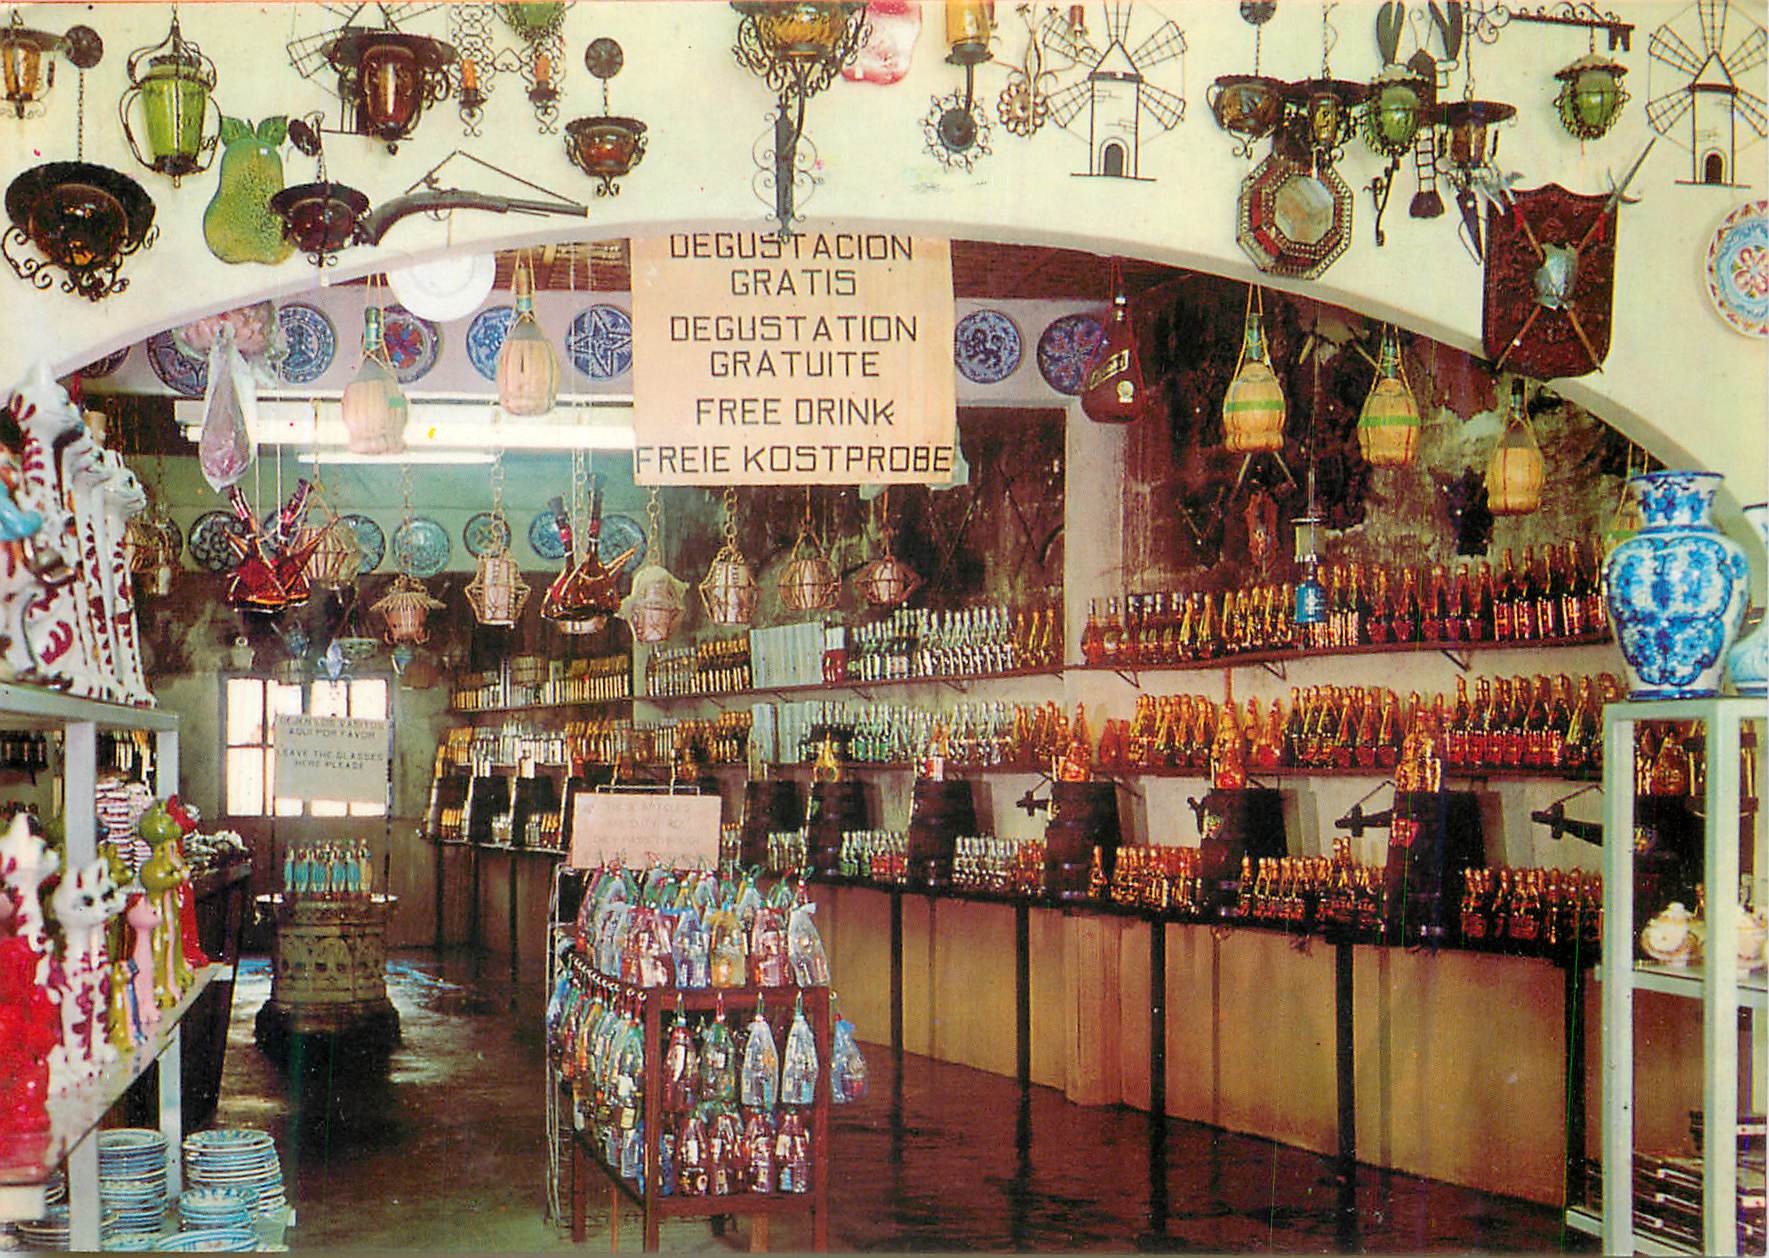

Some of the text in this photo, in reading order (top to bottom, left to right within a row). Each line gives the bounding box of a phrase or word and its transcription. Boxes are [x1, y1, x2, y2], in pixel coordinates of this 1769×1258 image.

[669, 233, 913, 260] DEGUSTACION
[731, 269, 857, 296] GRATIS
[670, 316, 917, 342] DEGUSTATION
[710, 350, 880, 377] GRATUITE
[697, 399, 895, 426] FREE DRINK
[635, 446, 952, 474] FREIE KOSTPROBE
[316, 728, 338, 738] POR
[340, 730, 375, 739] FAVOR
[314, 750, 332, 760] THE
[336, 752, 383, 761] GLASSES
[325, 761, 363, 770] PLEASE
